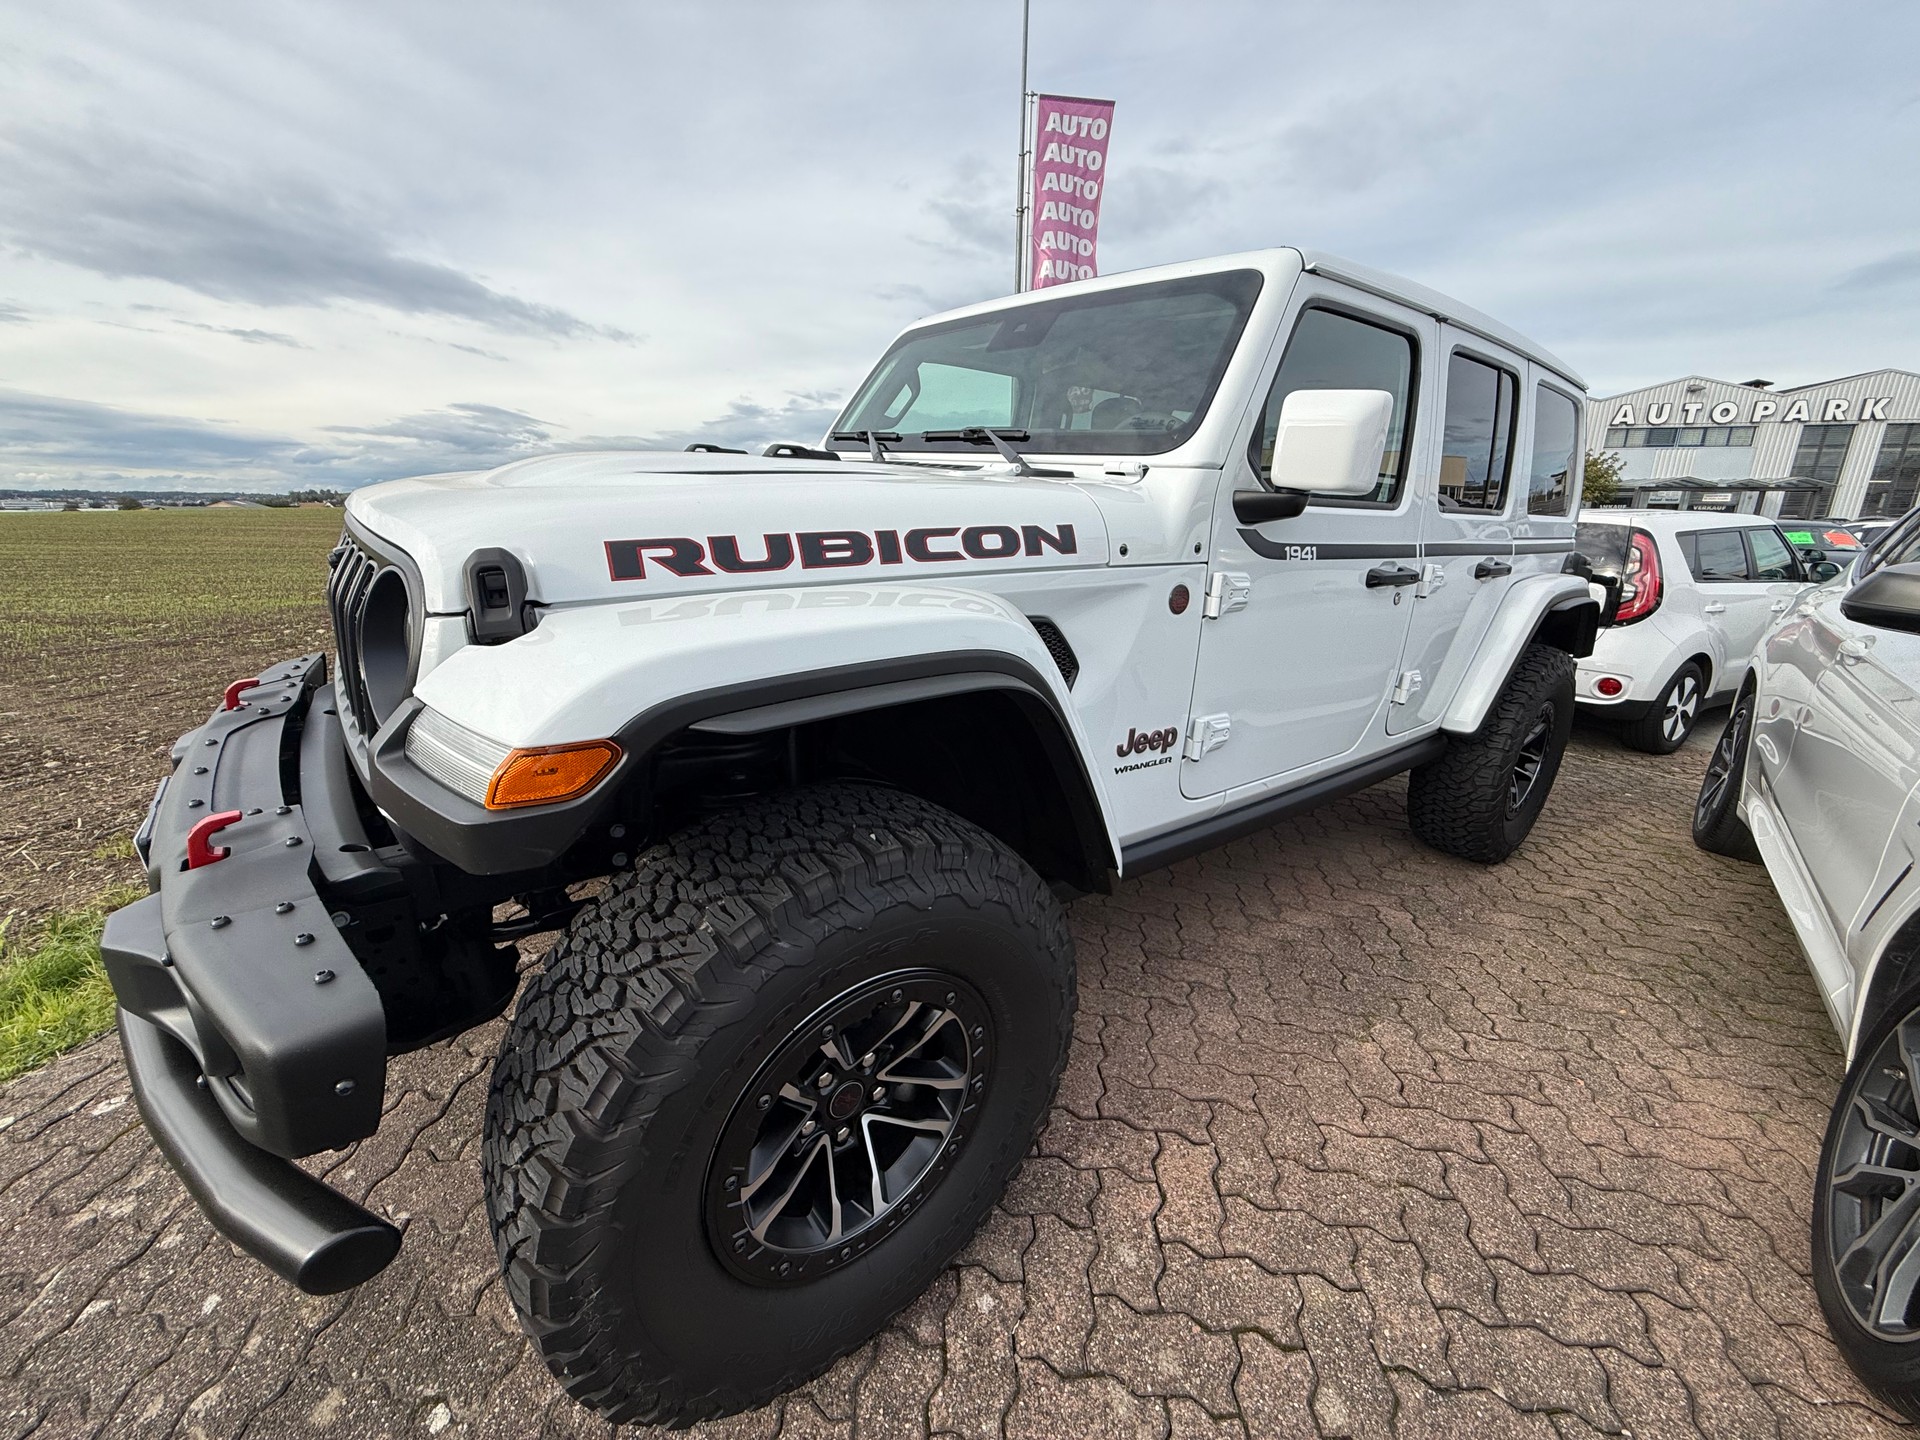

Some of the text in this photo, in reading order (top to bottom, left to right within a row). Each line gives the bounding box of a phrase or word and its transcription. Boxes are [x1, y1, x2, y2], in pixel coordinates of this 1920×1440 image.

[1044, 111, 1108, 140] AUTO
[1042, 142, 1103, 171] AUTO
[1041, 172, 1099, 200] AUTO
[1040, 201, 1095, 230] AUTO
[1039, 231, 1094, 257] AUTO
[1039, 259, 1094, 282] AUTO
[603, 523, 1078, 582] RUBICON
[1284, 546, 1317, 561] 1941
[1116, 726, 1178, 758] Jeep
[1113, 756, 1173, 775] WRANGLER
